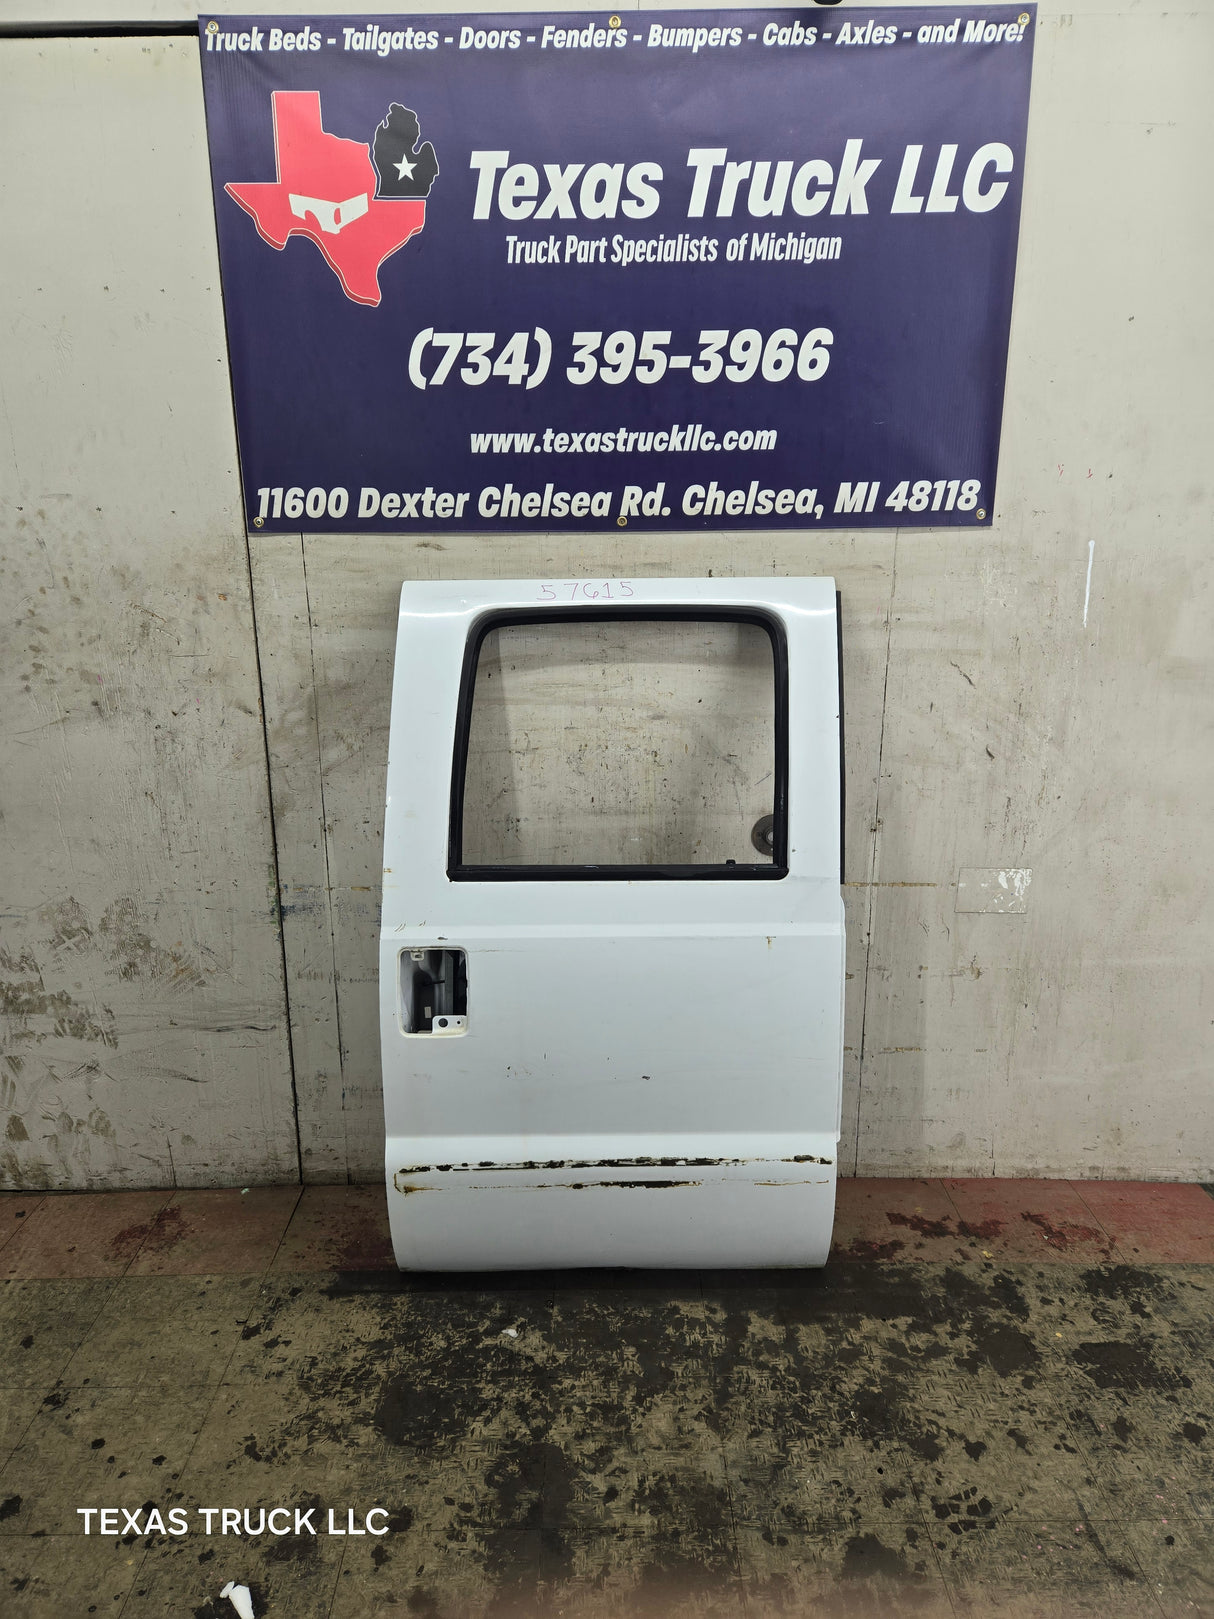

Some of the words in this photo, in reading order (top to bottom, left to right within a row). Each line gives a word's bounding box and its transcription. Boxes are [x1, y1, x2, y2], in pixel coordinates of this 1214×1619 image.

[205, 26, 264, 51] Truck
[269, 26, 321, 51] Beds
[343, 24, 439, 56] Tailgates
[459, 27, 521, 49] Doors
[541, 24, 627, 48] Fenders
[647, 24, 742, 53] Bumpers
[763, 21, 817, 46] Cabs
[835, 20, 897, 44] Axles
[918, 18, 960, 43] and
[963, 19, 1026, 42] More!
[470, 151, 663, 220] Texas
[687, 139, 882, 217] Truck
[891, 143, 1013, 213] LLC
[506, 236, 561, 263] Truck
[565, 235, 607, 263] Part
[611, 234, 718, 266] Specialists
[726, 233, 748, 261] of
[750, 232, 842, 263] Michigan
[409, 327, 551, 389] (734)
[567, 328, 833, 384] 395-3966
[471, 425, 777, 452] www.texastruckllc.com
[257, 487, 348, 518] 11600
[358, 488, 469, 517] Dexter
[479, 484, 612, 517] Chelsea
[620, 483, 670, 516] Rd.
[683, 481, 823, 519] Chelsea,
[834, 482, 880, 512] MI
[885, 480, 981, 511] 48118
[536, 581, 634, 600] 57615
